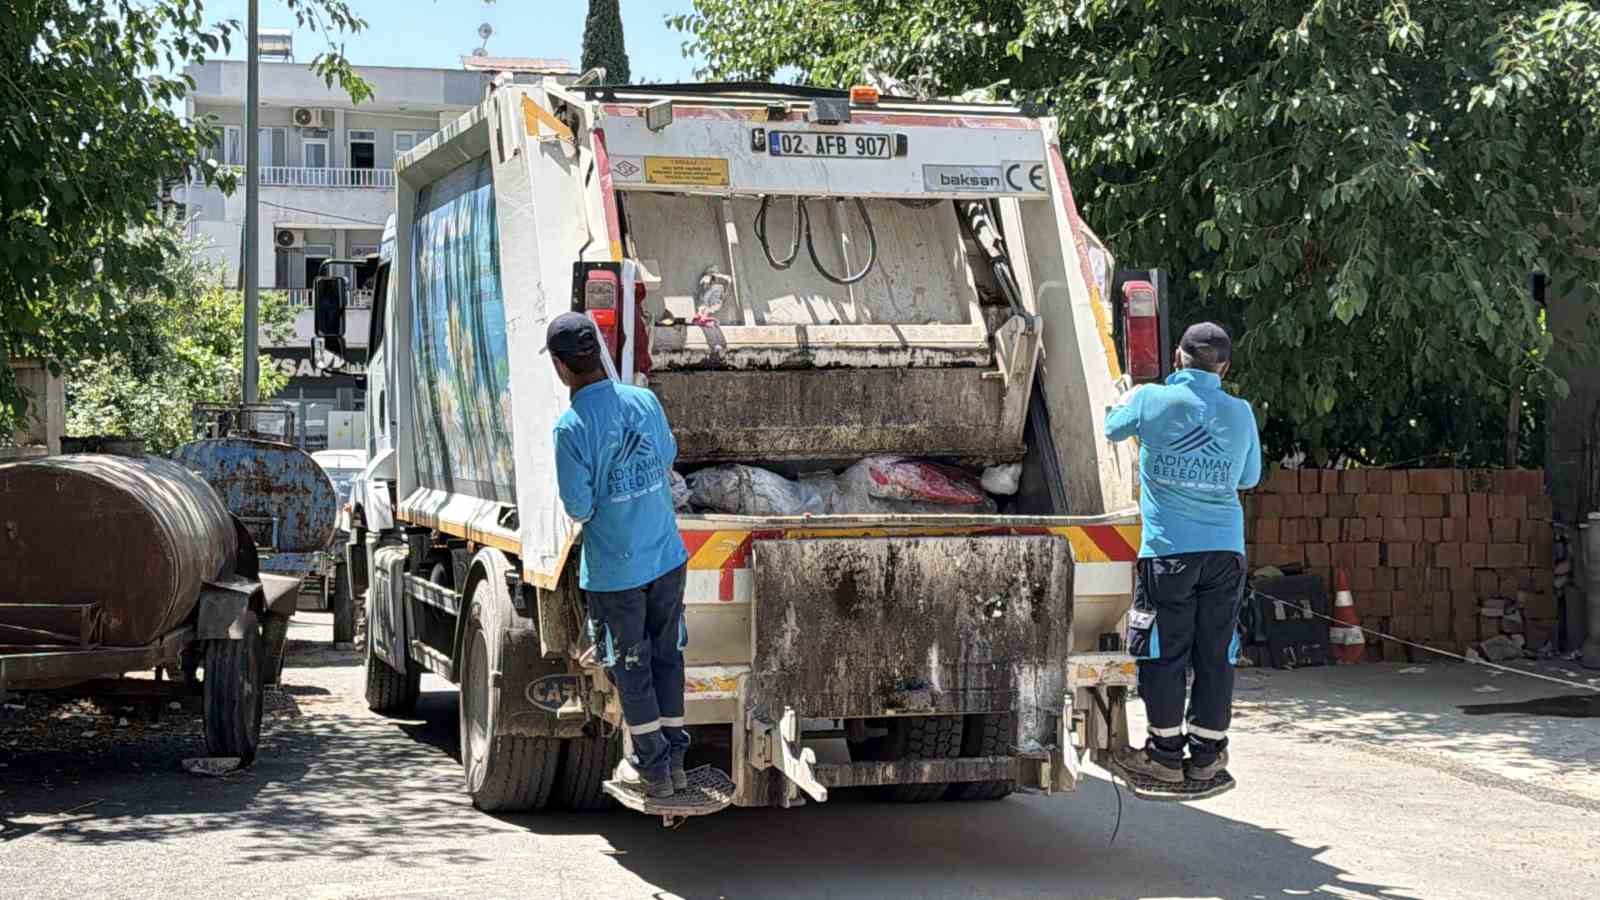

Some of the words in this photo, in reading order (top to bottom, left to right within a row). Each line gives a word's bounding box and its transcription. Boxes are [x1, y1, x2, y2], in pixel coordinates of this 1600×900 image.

[782, 134, 803, 154] 02
[816, 135, 847, 155] AFB
[855, 136, 887, 156] 907
[940, 172, 1000, 187] baksan
[1006, 163, 1046, 192] CE
[1155, 453, 1232, 471] ADIYAMAN
